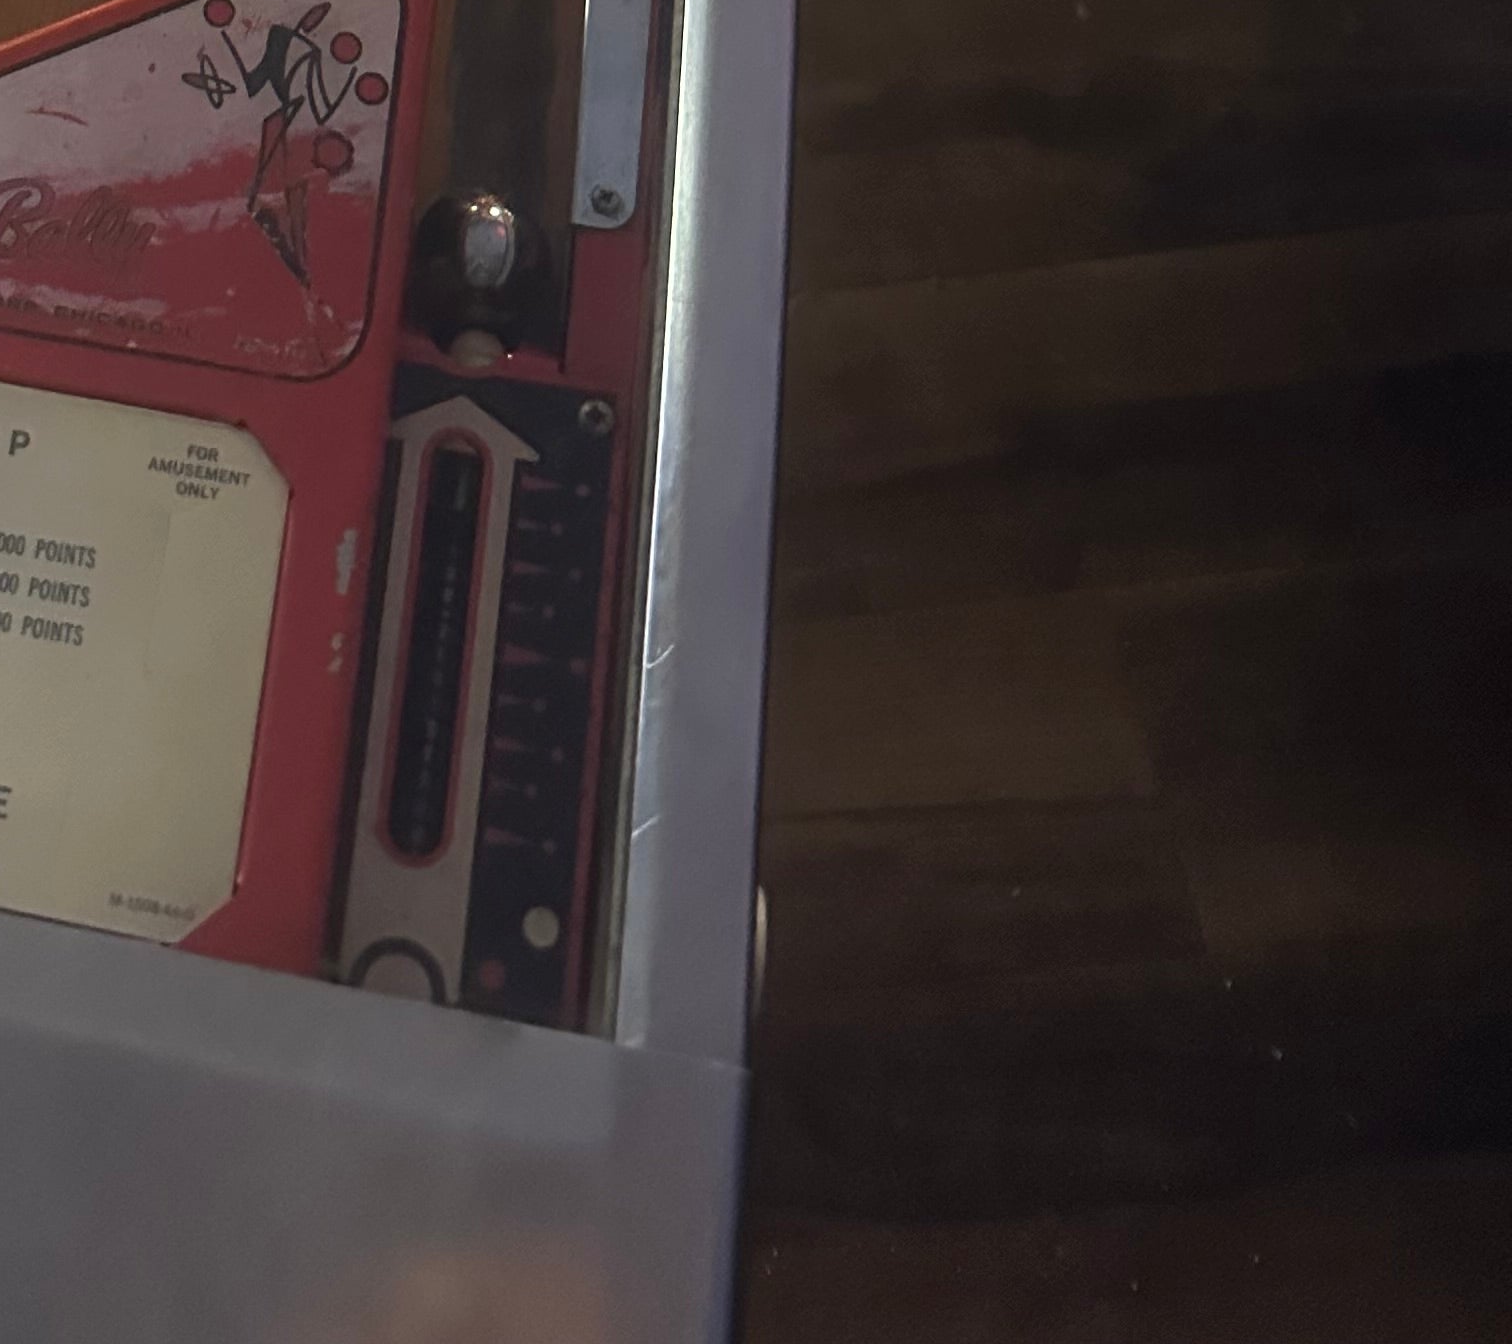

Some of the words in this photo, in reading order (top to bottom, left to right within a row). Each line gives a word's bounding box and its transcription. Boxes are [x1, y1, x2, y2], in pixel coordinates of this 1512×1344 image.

[186, 444, 219, 463] FOR
[147, 456, 251, 488] AMUSEMENT
[175, 480, 221, 501] ONLY
[34, 538, 97, 570] POINTS
[27, 577, 91, 609] POINTS
[20, 614, 85, 648] POINTS
